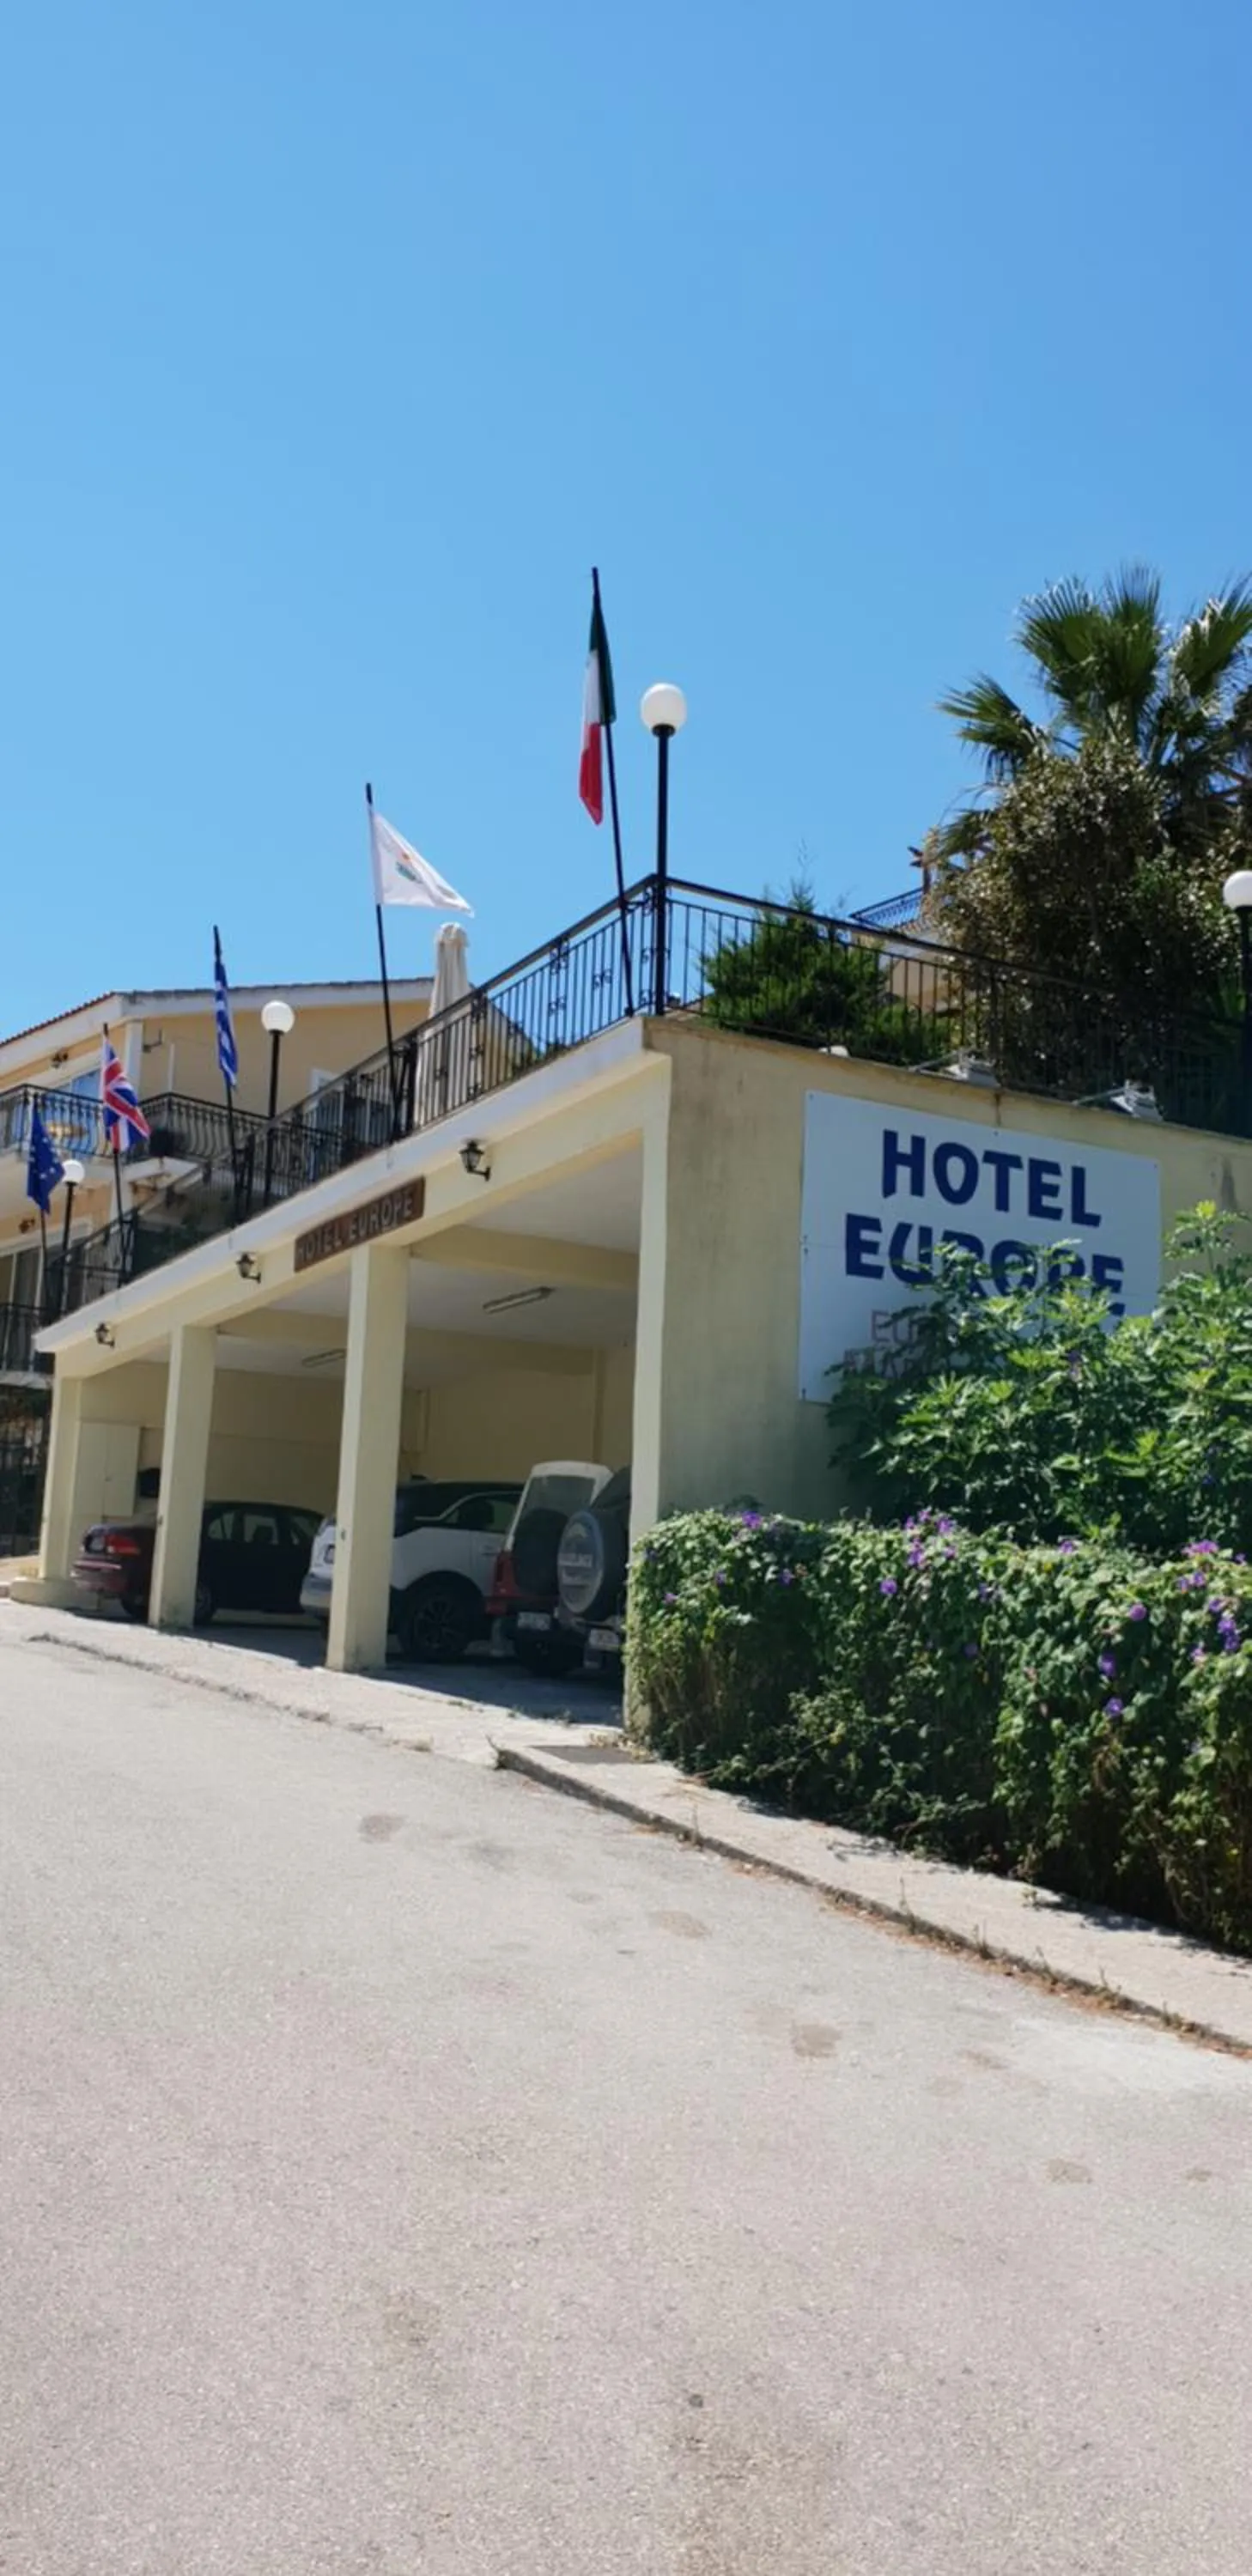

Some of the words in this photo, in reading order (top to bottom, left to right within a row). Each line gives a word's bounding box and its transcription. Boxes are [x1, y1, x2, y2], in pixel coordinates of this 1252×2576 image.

[882, 1128, 1102, 1228] HOTEL
[297, 1220, 343, 1261] HOTEL
[349, 1186, 413, 1240] EUROPE
